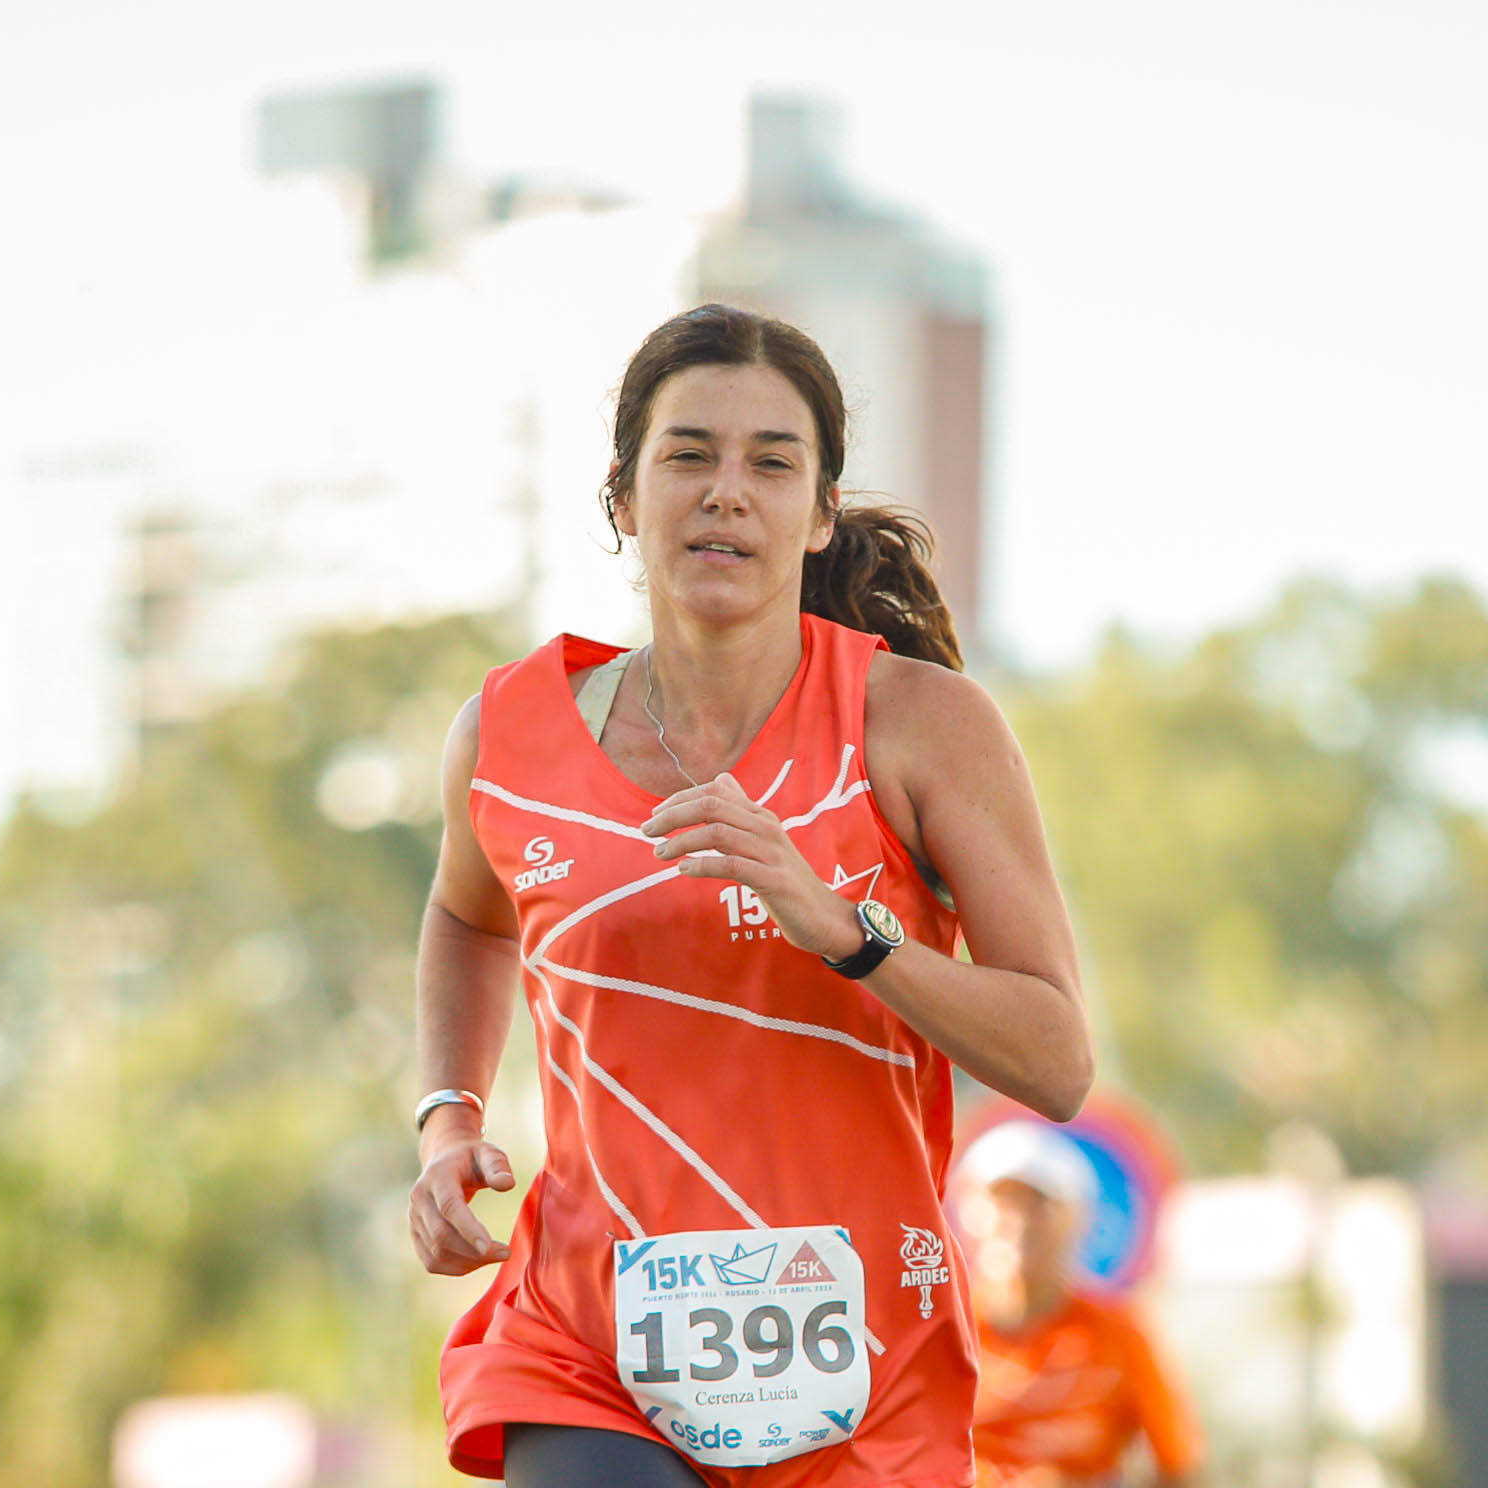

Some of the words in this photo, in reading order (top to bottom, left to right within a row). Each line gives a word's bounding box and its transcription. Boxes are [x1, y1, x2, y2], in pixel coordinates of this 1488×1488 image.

[719, 884, 769, 927] 15
[730, 928, 781, 942] PUER
[642, 1254, 706, 1292] 15K
[789, 1260, 823, 1279] 15K
[900, 1267, 949, 1288] ARDEC
[630, 1301, 855, 1383] 1396
[695, 1390, 755, 1406] Cerenza
[670, 1418, 743, 1450] osde
